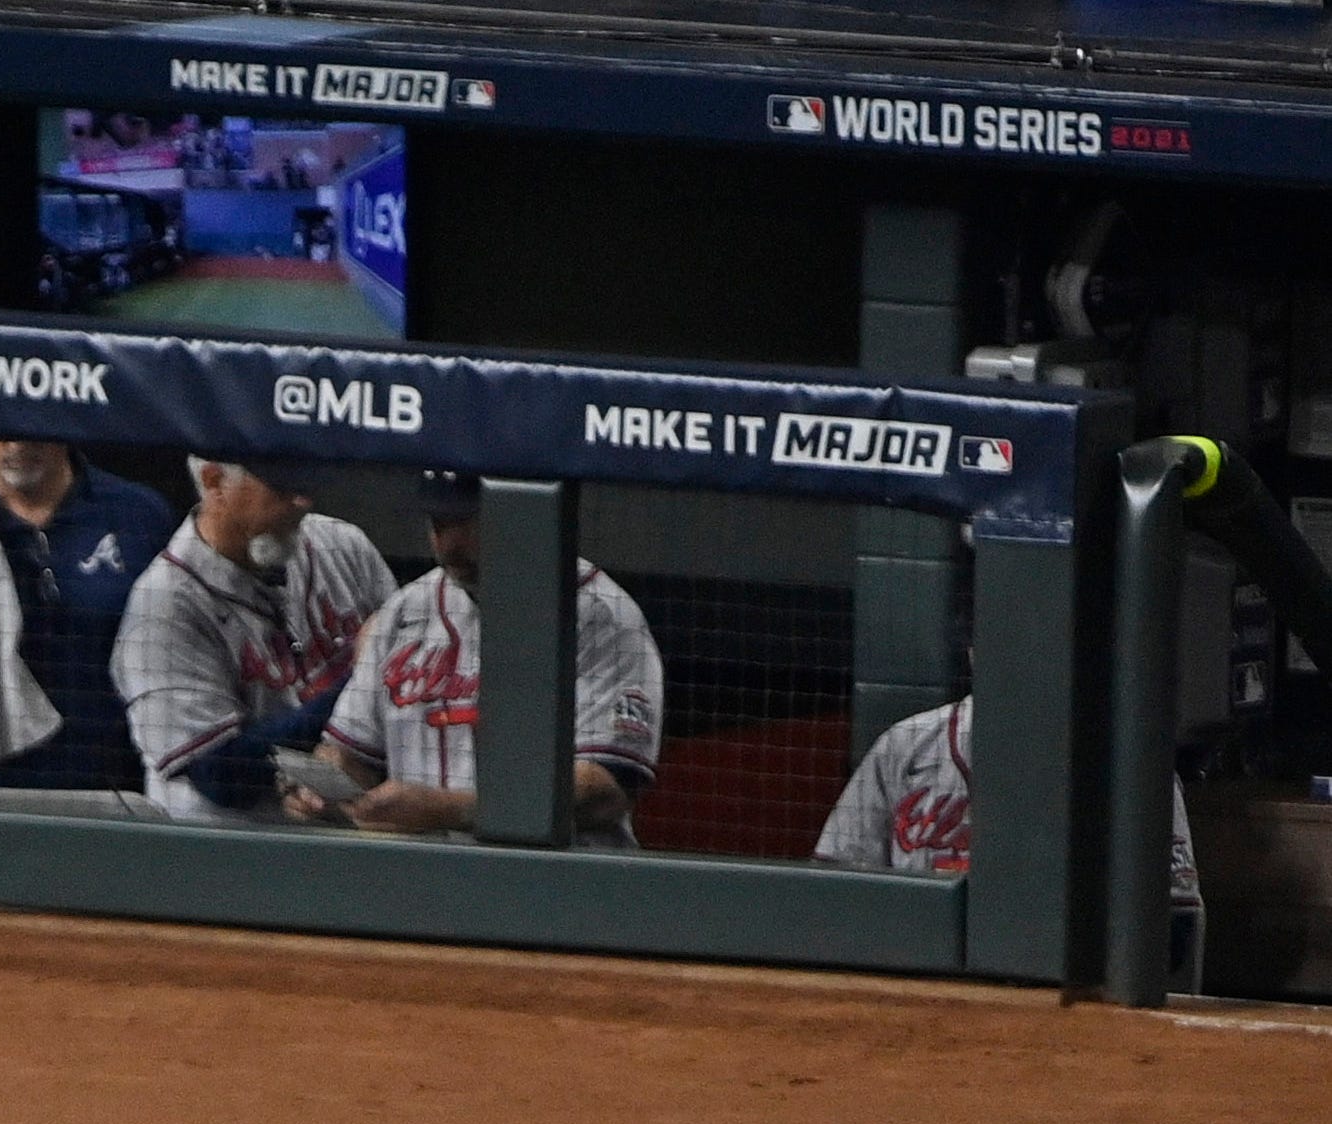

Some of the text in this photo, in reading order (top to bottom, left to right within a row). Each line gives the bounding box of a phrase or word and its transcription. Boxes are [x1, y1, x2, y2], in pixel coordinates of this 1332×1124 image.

[171, 59, 439, 106] MAKE IT MAJOR
[833, 96, 1192, 157] WORLD SERIES 2021
[273, 375, 423, 432] @MLB
[585, 404, 936, 468] MAKE IT MAJOR
